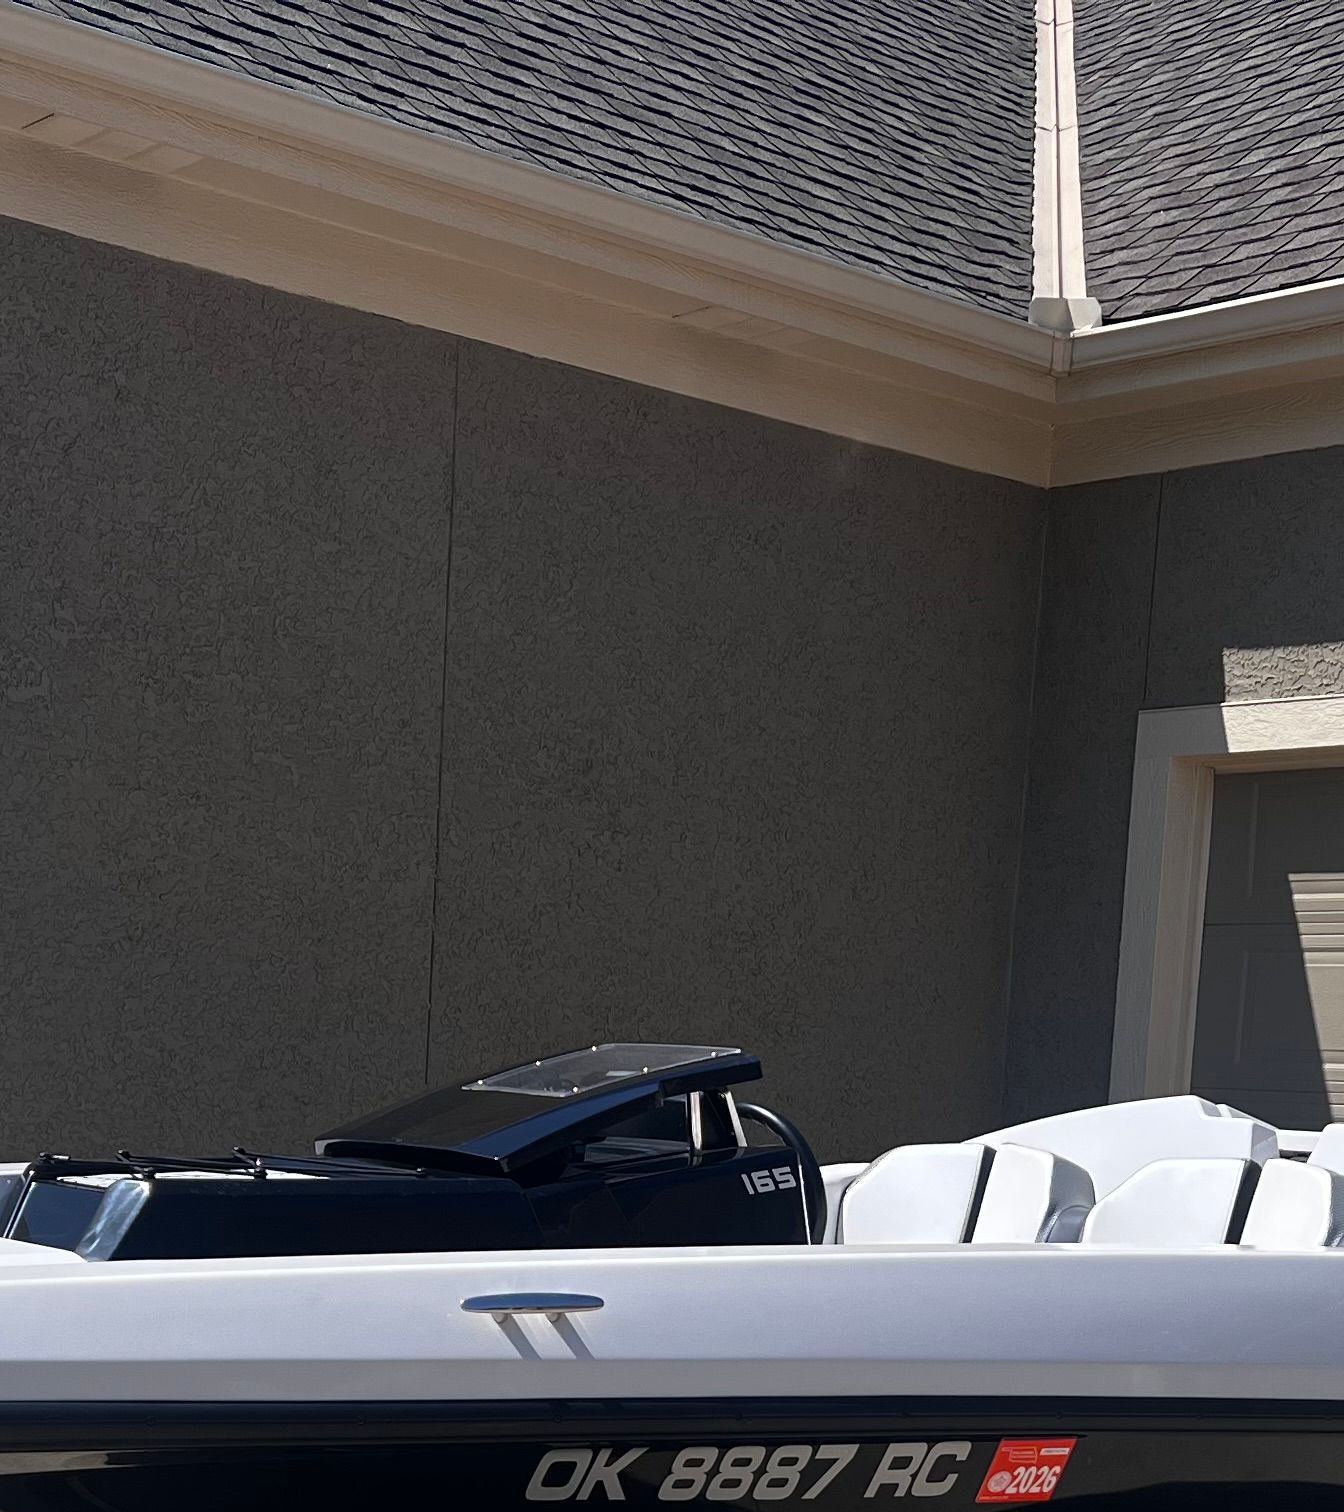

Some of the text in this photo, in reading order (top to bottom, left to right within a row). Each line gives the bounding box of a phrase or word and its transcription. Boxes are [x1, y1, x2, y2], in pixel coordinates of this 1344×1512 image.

[740, 1166, 797, 1195] 165
[525, 1441, 972, 1501] OK 8887 RC
[1004, 1465, 1061, 1495] 2026
